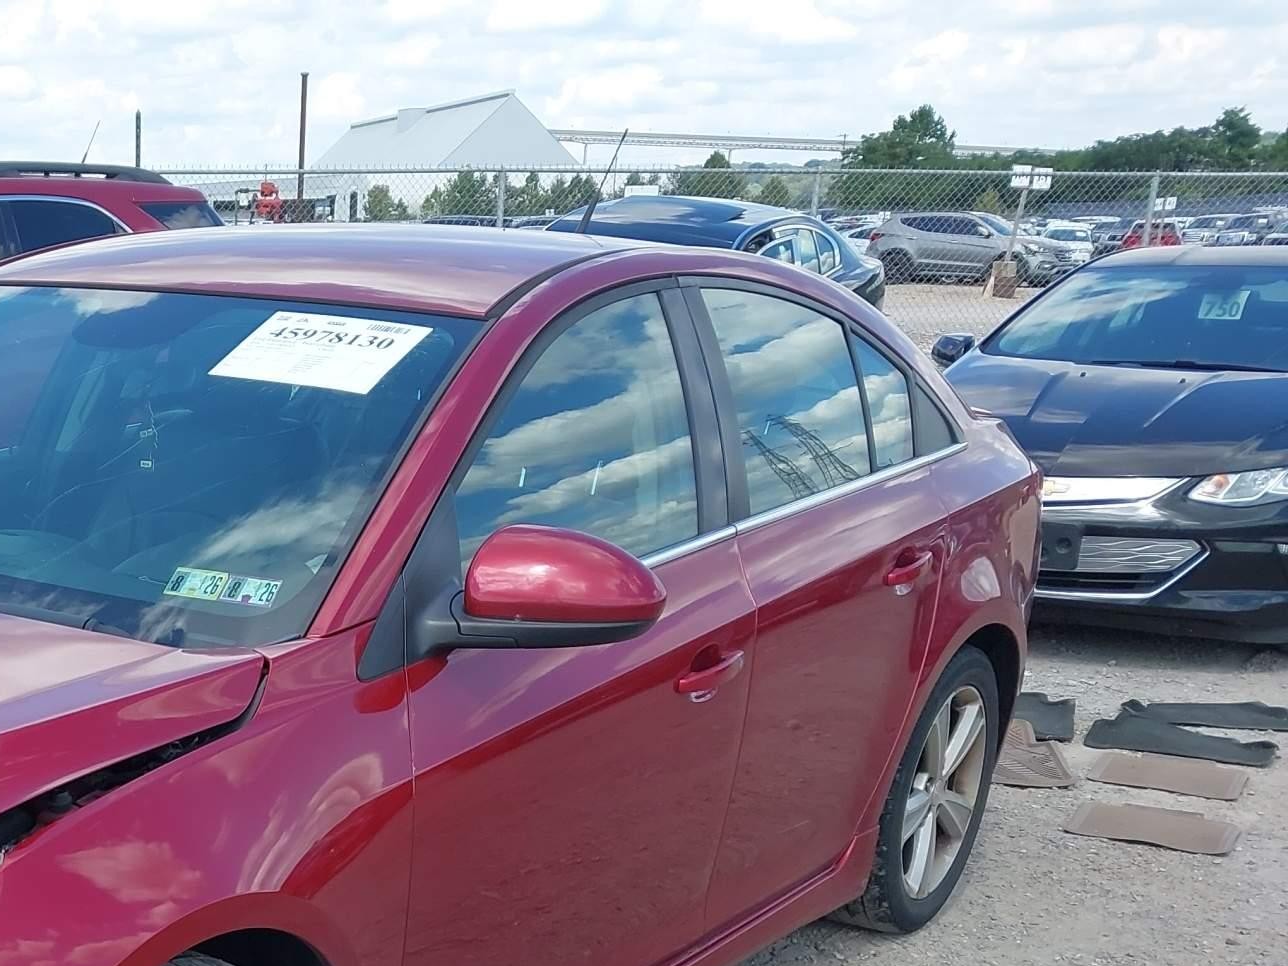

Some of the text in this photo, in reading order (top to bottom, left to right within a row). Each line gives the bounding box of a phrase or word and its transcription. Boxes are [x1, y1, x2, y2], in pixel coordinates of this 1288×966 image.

[1203, 301, 1241, 318] 750
[269, 326, 395, 350] 45978130
[204, 576, 223, 594] 26
[258, 582, 278, 602] 26
